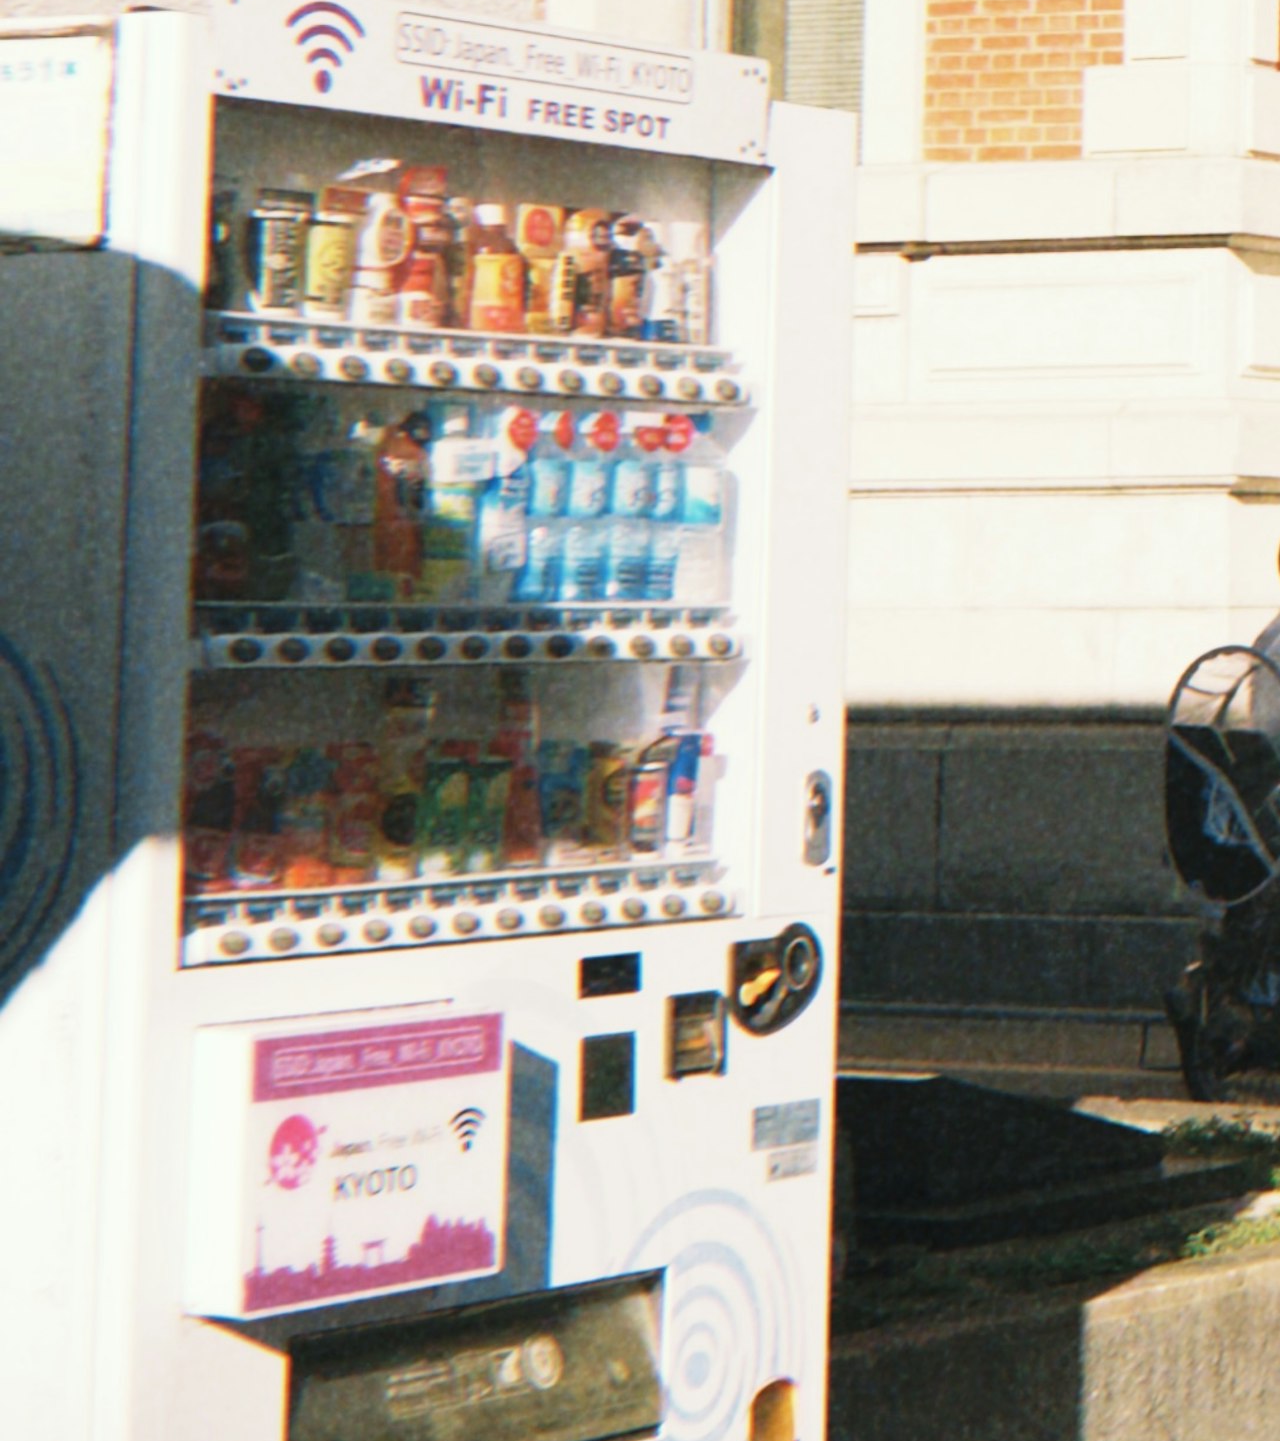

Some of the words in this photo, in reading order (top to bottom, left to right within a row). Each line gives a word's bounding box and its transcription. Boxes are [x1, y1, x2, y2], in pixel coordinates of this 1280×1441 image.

[420, 75, 508, 119] Wi-Fi
[527, 98, 596, 130] FREE
[602, 108, 672, 139] SPOT
[335, 1163, 418, 1202] KYOTO
